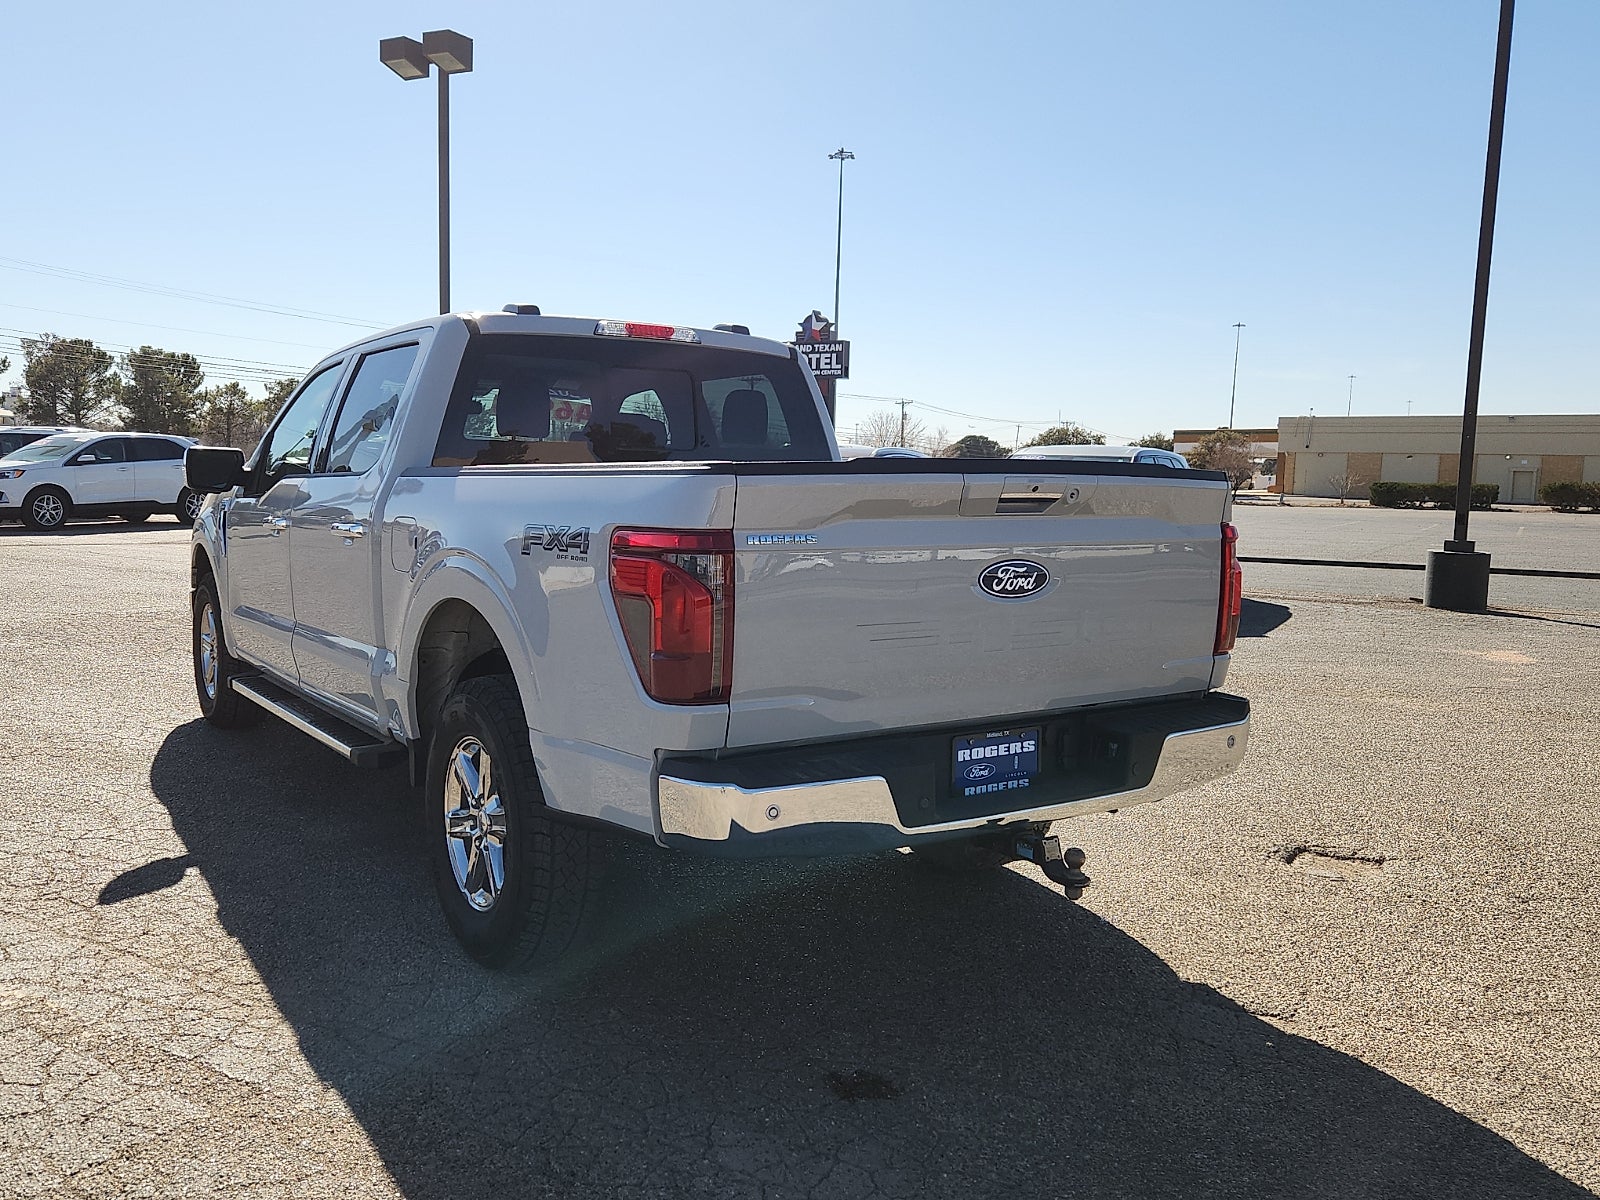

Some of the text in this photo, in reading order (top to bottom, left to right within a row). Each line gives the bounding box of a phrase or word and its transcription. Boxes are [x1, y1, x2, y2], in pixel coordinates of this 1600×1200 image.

[814, 343, 842, 352] TEXAN
[521, 524, 590, 555] FX4
[747, 535, 817, 545] ROGERS
[992, 566, 1038, 591] Ford
[957, 740, 1036, 762] ROGERS
[969, 765, 990, 778] Ford
[964, 778, 1030, 796] ROGERS
